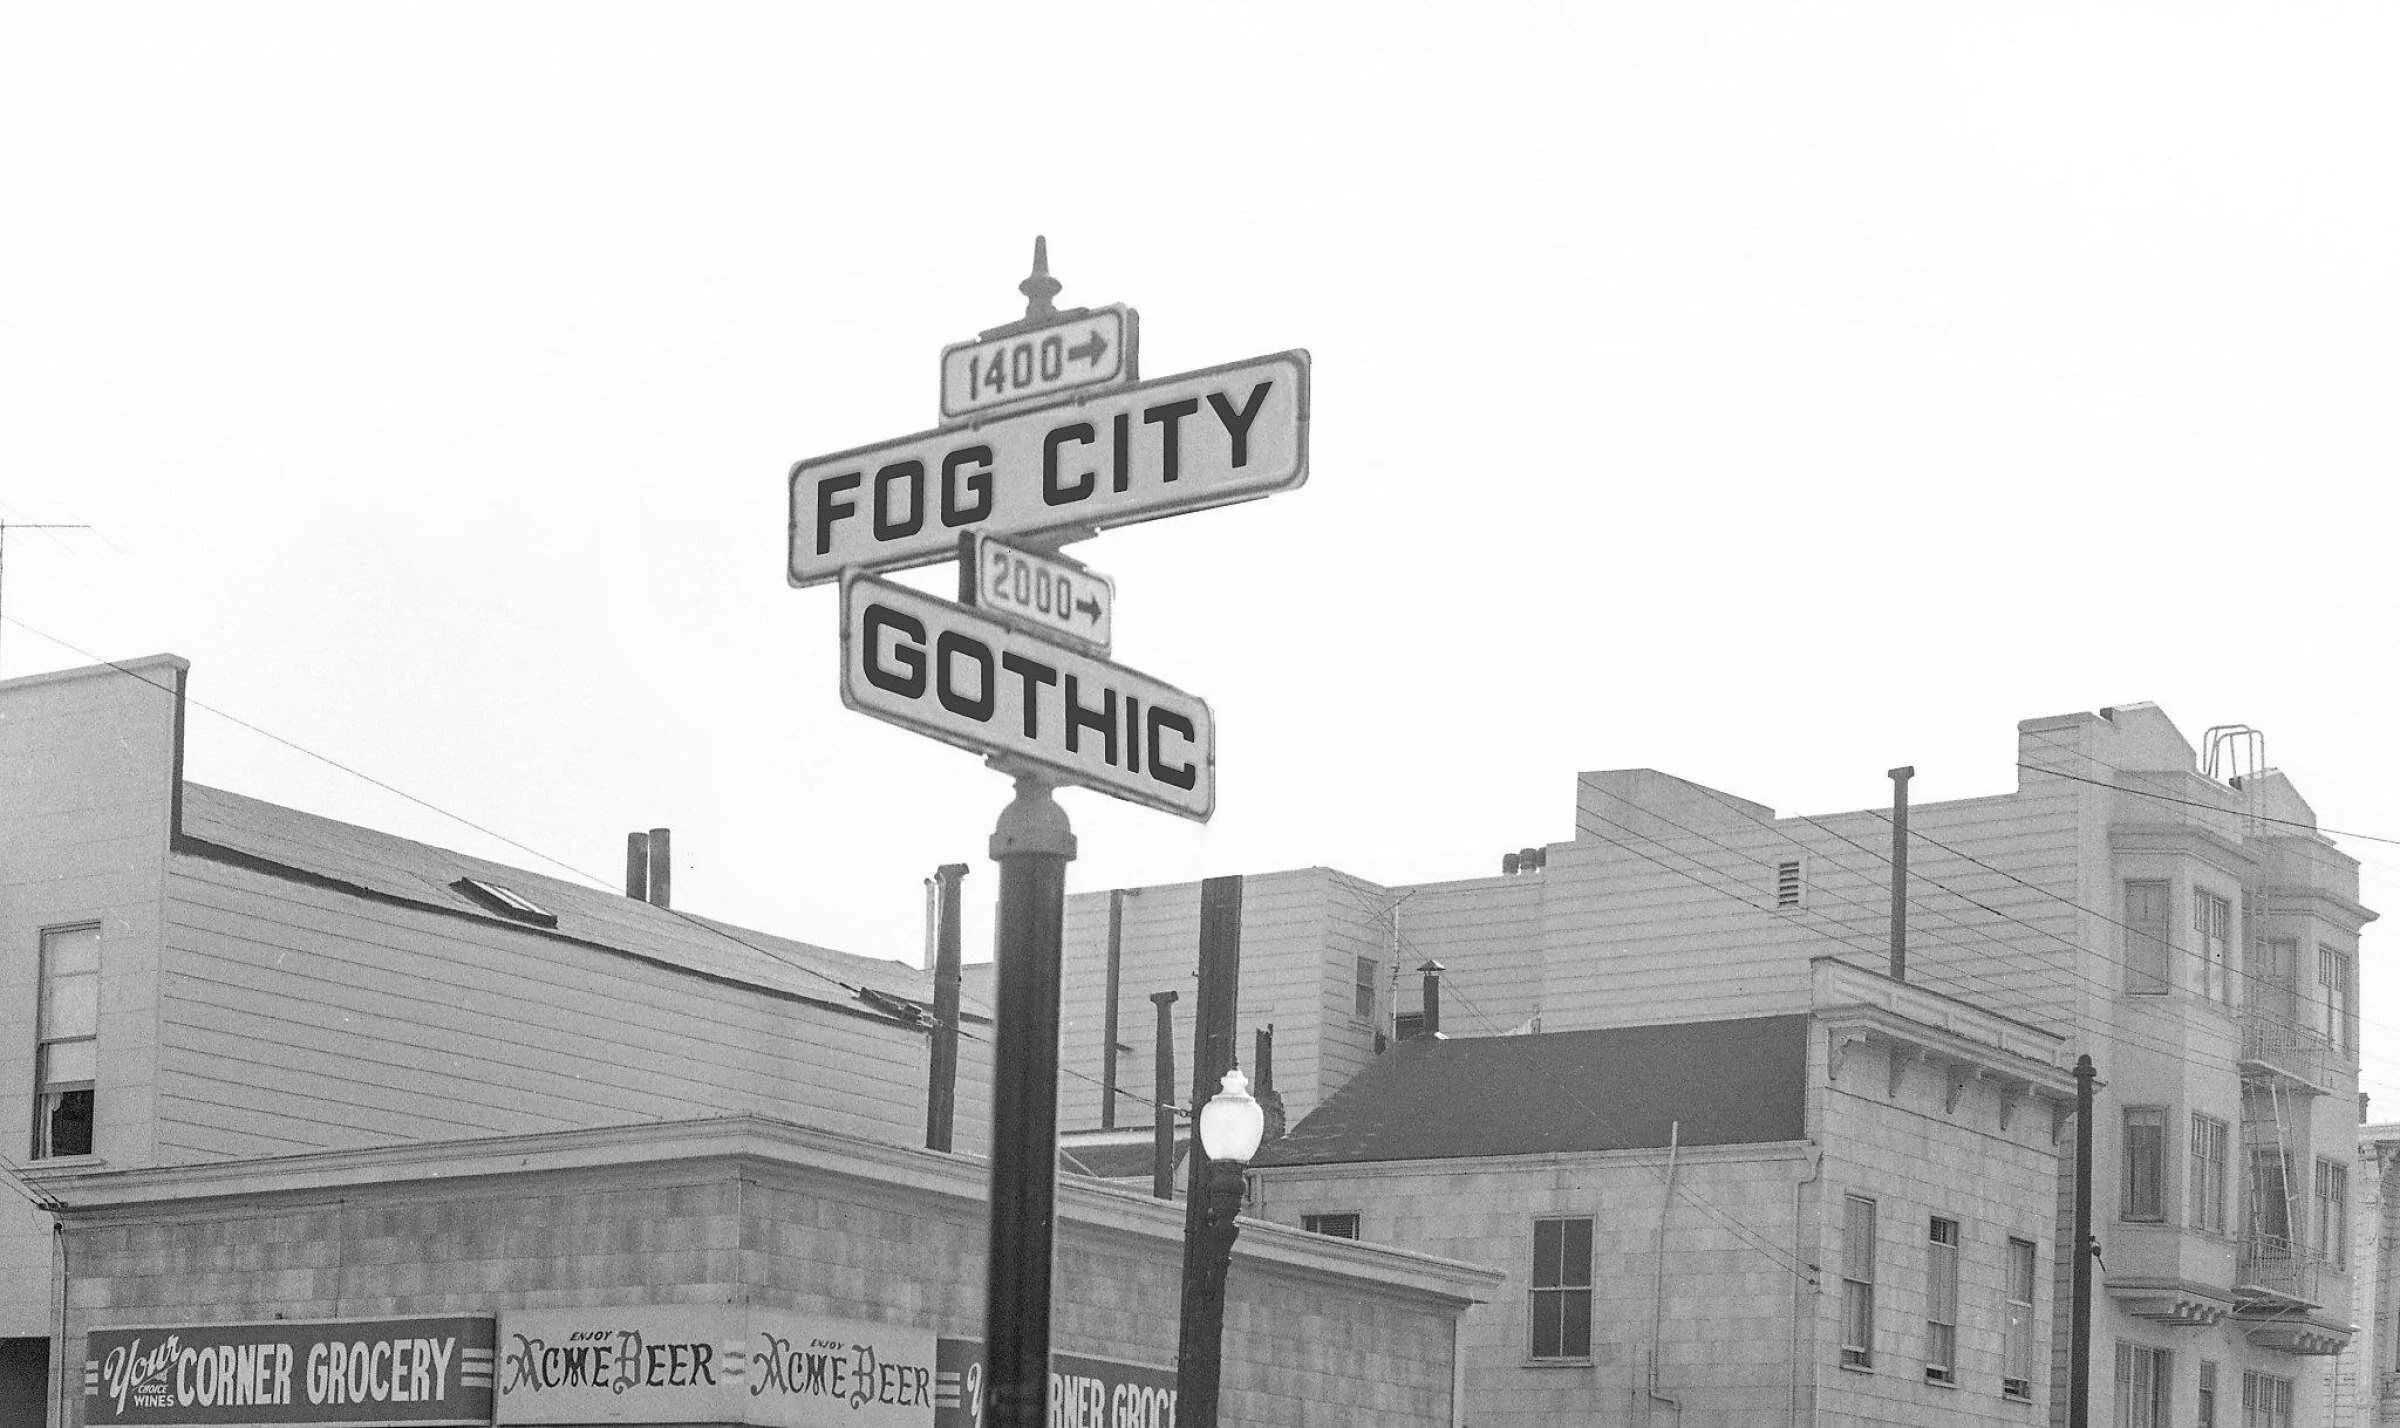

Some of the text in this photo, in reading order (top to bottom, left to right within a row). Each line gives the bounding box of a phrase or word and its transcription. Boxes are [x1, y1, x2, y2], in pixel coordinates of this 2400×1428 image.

[969, 335, 1063, 401] 1400
[816, 381, 1274, 556] FOG CITY
[993, 552, 1071, 620] 2000
[863, 603, 1196, 791] GOTHIC
[502, 1329, 717, 1395] ACME BEER
[570, 1330, 613, 1341] ENJOY
[810, 1338, 845, 1350] ENJOY
[104, 1335, 456, 1416] Your CORNER GROCERY
[133, 1394, 175, 1408] WINES
[138, 1384, 169, 1394] CHOICE
[750, 1332, 847, 1399] ACME
[850, 1345, 931, 1410] BEER
[1048, 1373, 1106, 1428] RNER
